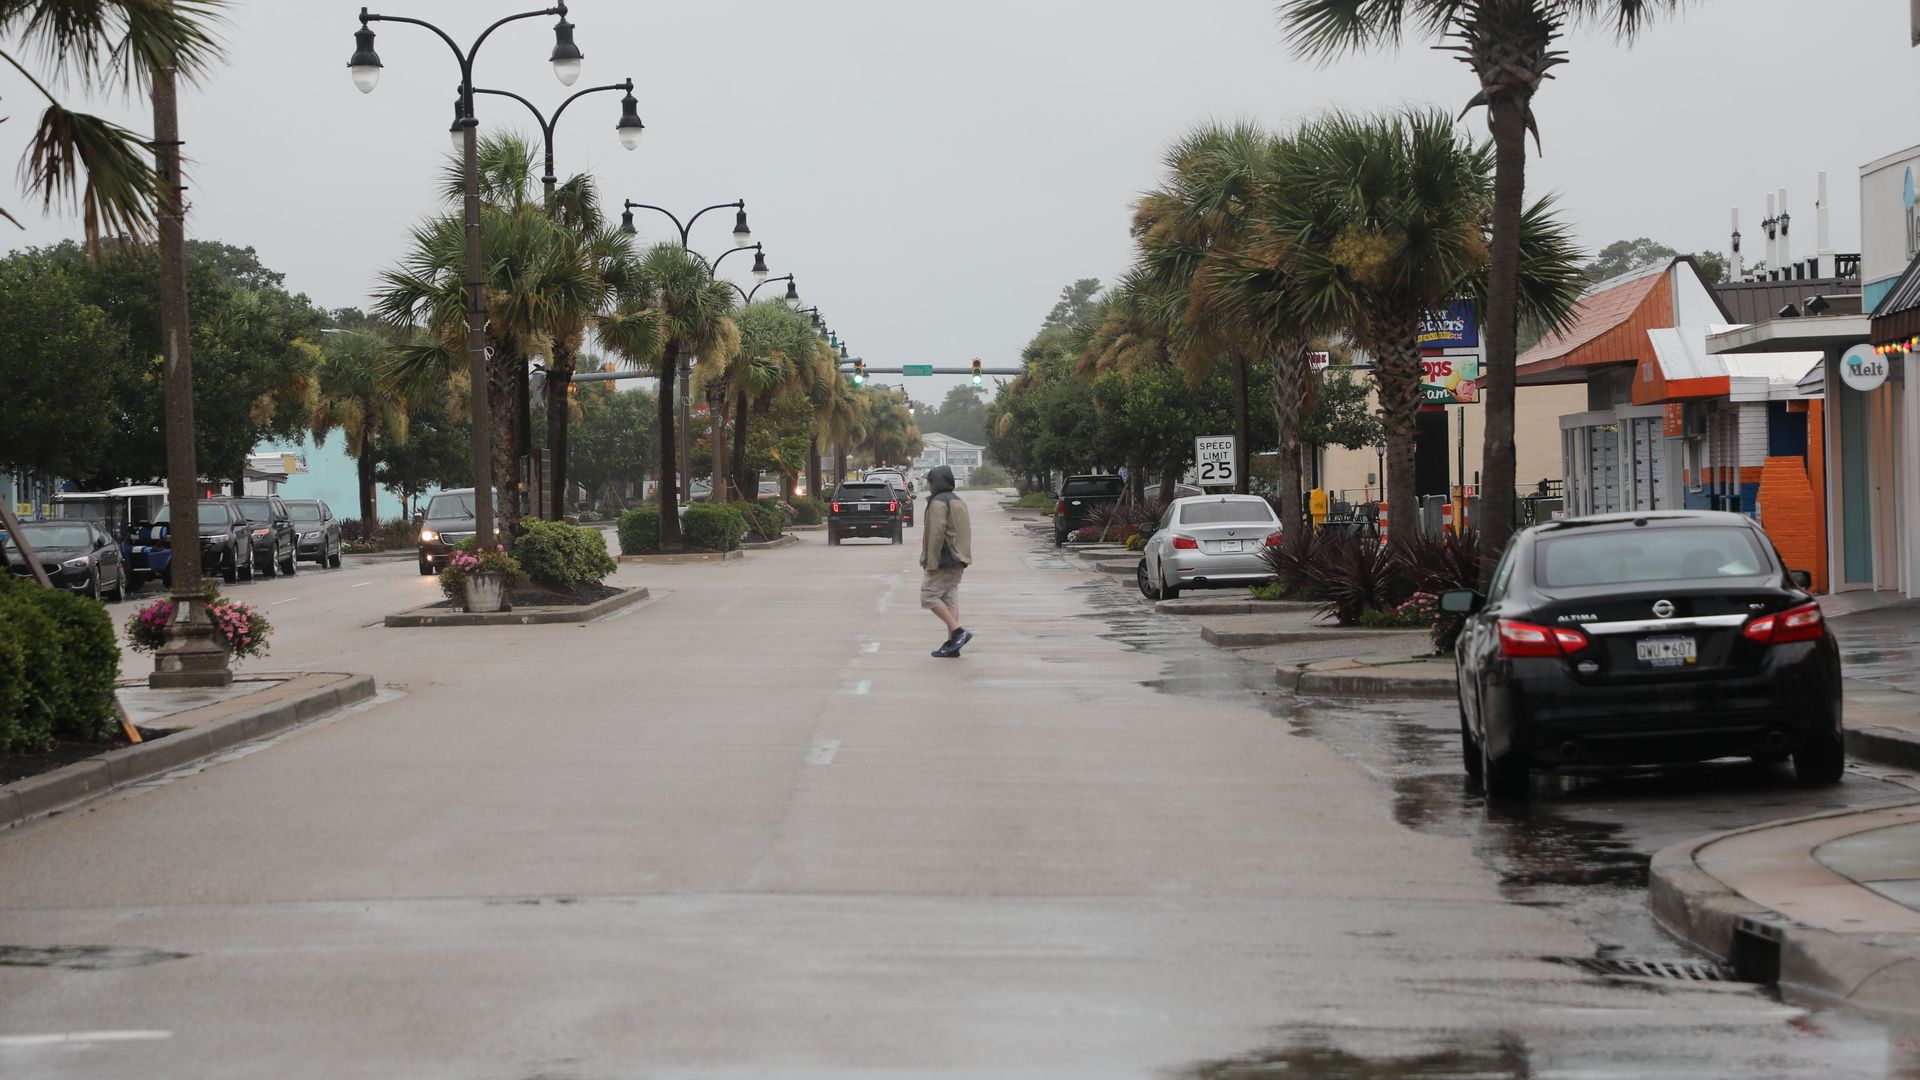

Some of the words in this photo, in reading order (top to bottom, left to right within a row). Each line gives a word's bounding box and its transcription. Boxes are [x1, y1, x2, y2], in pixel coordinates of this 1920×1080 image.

[1421, 361, 1452, 383] ops
[1421, 388, 1450, 399] am
[1200, 442, 1231, 450] SPEED
[1203, 452, 1228, 460] LIMIT
[1201, 462, 1232, 479] 25
[1557, 614, 1598, 622] ALTIMA
[1671, 642, 1692, 656] 607
